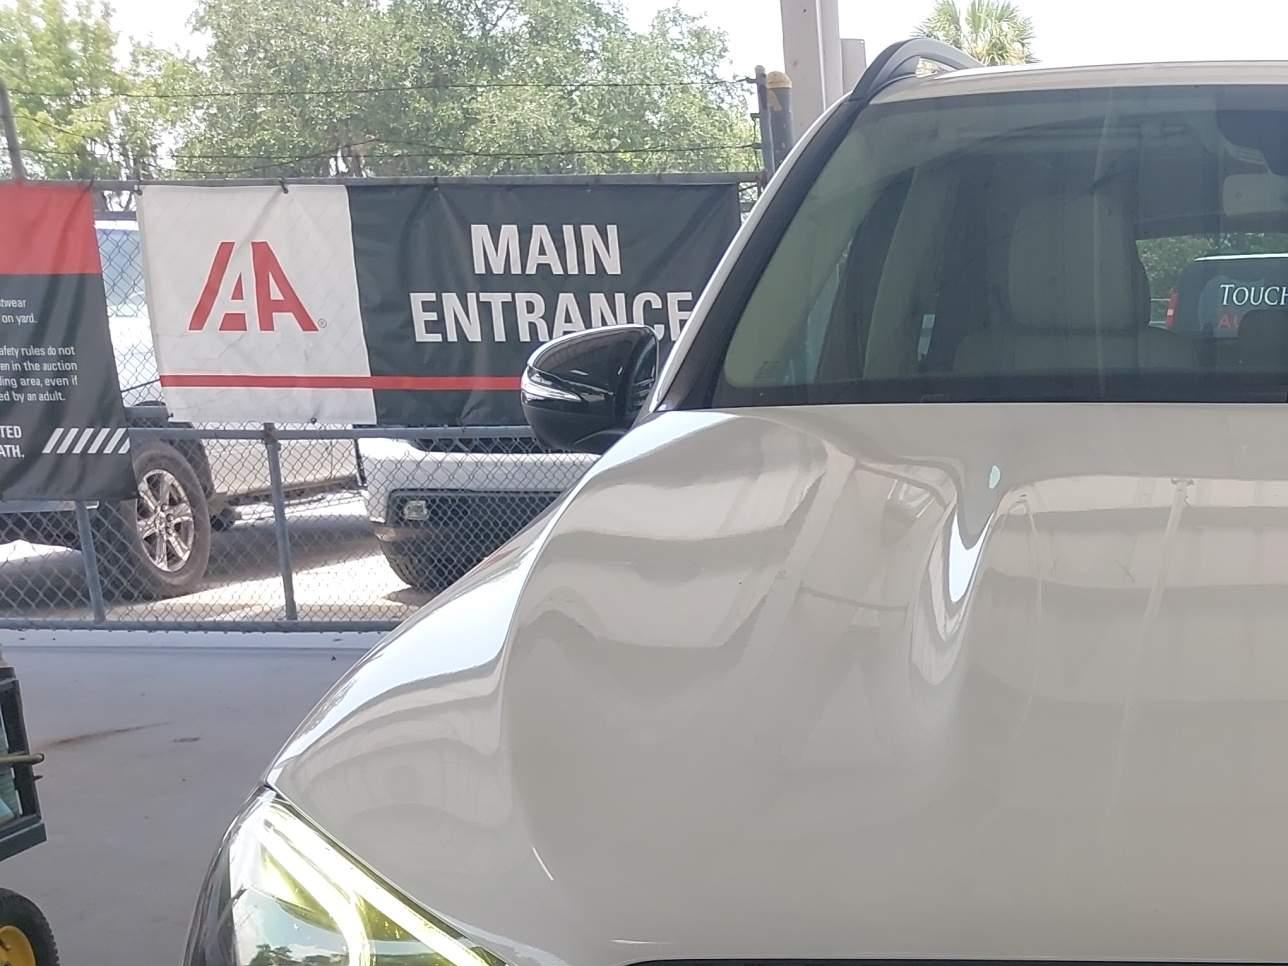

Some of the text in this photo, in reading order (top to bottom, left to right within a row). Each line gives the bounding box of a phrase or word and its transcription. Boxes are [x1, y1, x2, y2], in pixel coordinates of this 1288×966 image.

[470, 224, 622, 275] MAIN
[2, 313, 38, 326] on yard.
[21, 345, 45, 356] rules
[47, 346, 57, 356] do
[58, 346, 76, 356] not
[12, 360, 21, 371] in
[23, 360, 40, 371] the
[43, 361, 78, 371] auction
[20, 377, 43, 388] area,
[44, 377, 70, 387] even
[70, 374, 79, 386] if
[12, 390, 25, 404] by
[27, 392, 37, 401] an
[38, 390, 66, 401] adult.
